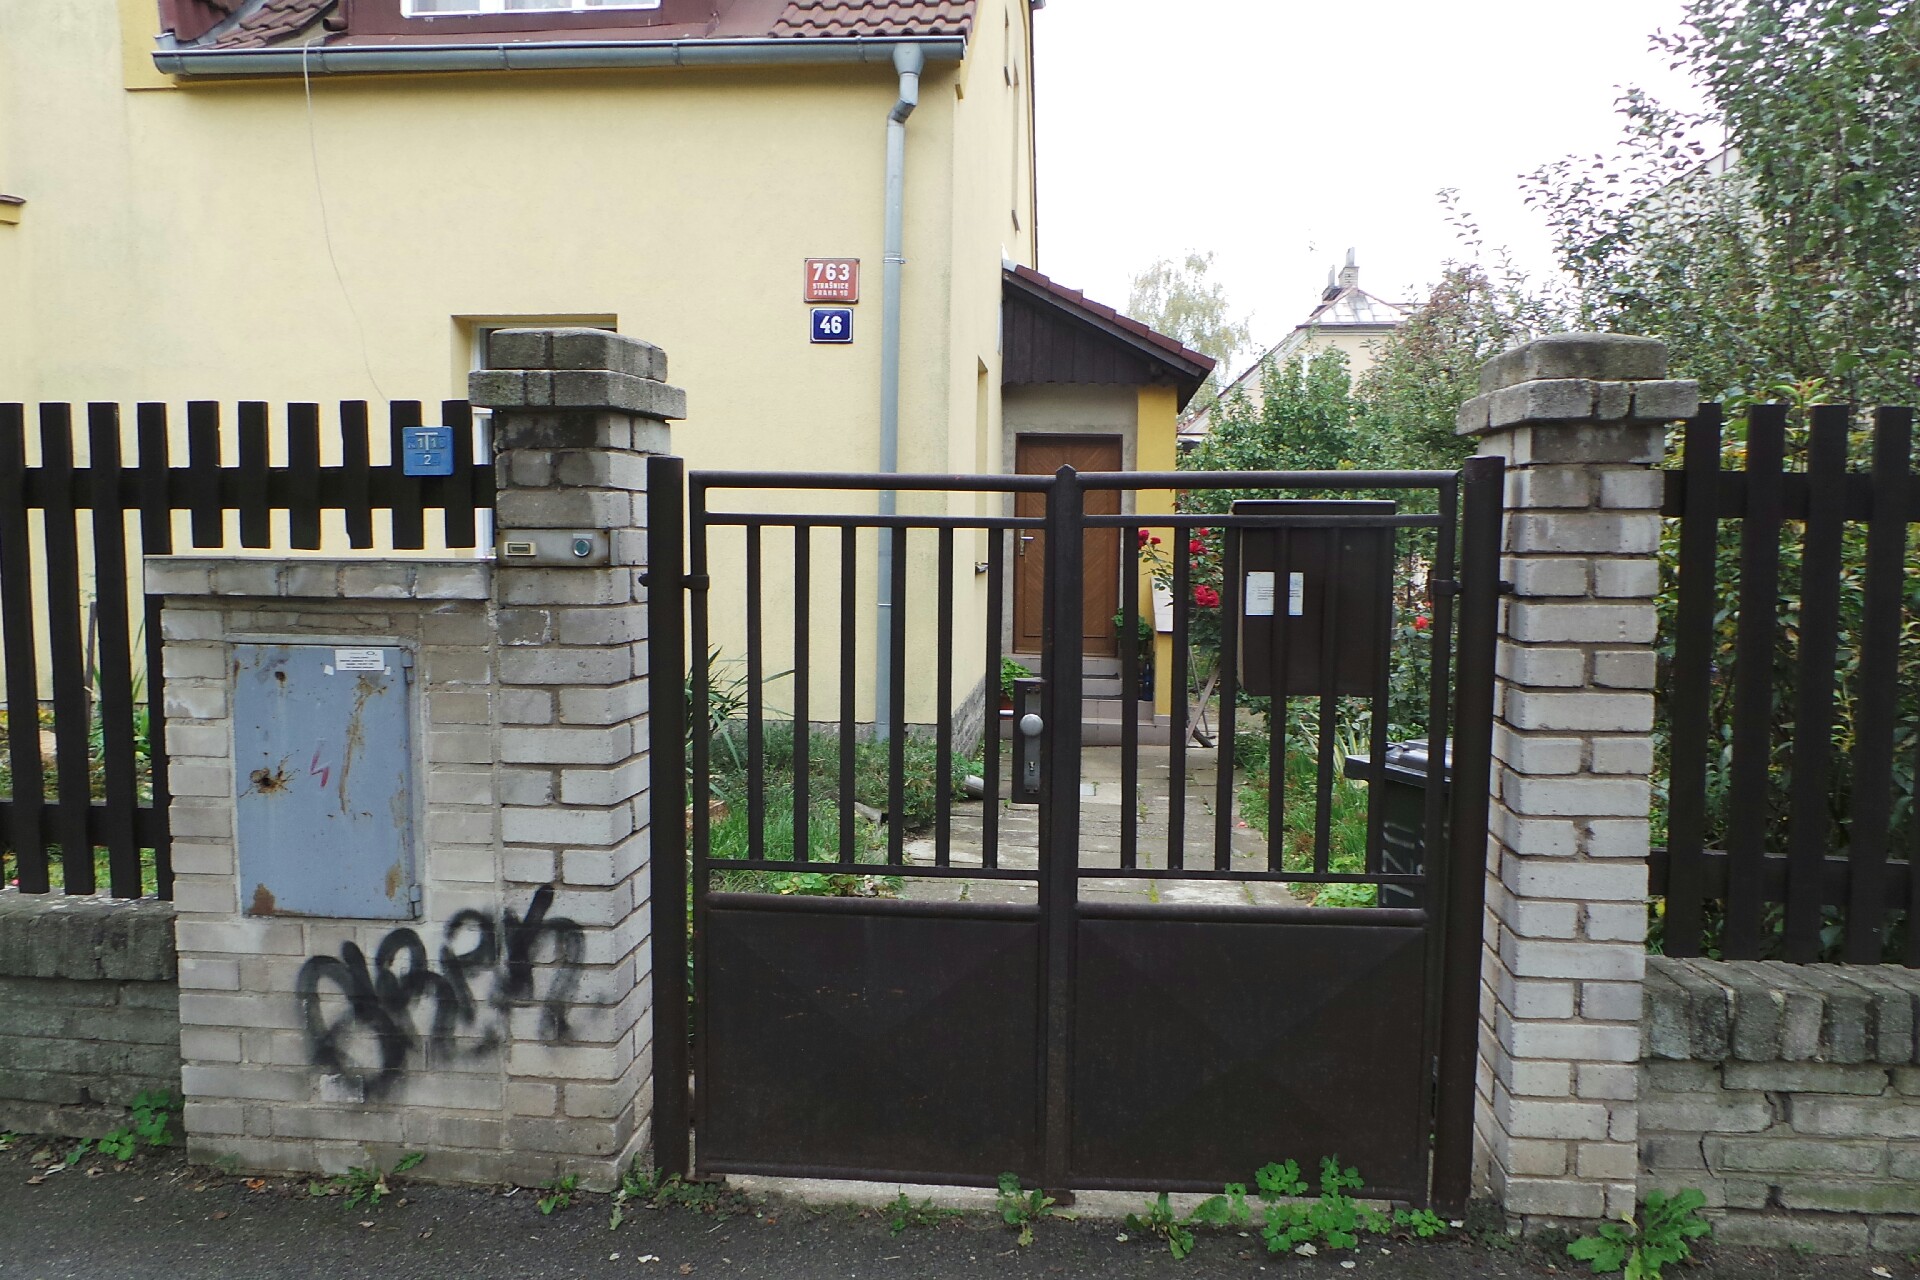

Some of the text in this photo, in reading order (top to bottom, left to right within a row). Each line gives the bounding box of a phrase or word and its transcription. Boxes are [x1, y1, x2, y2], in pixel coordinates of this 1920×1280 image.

[812, 263, 850, 281] 763
[812, 281, 849, 290] STRAŠNICE
[820, 315, 843, 334] 46
[423, 454, 432, 465] 2
